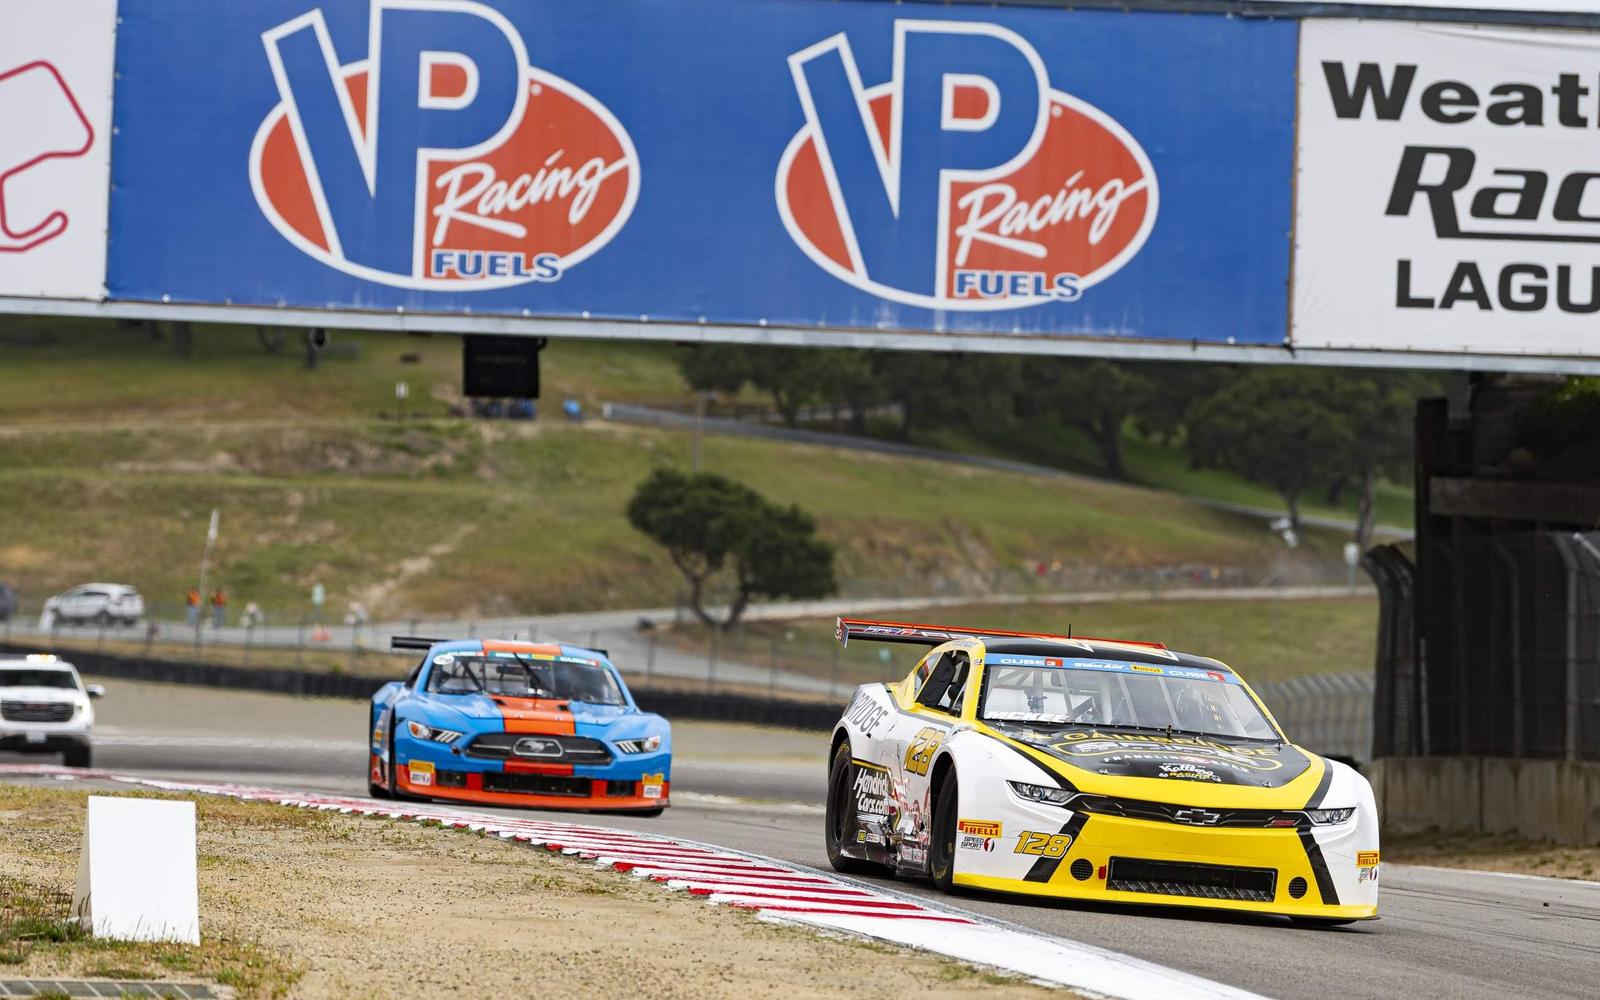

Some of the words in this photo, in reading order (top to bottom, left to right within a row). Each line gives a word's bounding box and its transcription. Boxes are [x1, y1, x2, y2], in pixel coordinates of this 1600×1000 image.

[1321, 61, 1600, 128] Weat
[261, 0, 530, 281] VP
[787, 18, 1051, 300] VP
[433, 149, 625, 246] Racing
[956, 170, 1144, 267] Racing
[432, 249, 562, 281] FUELS
[953, 268, 1084, 301] FUELS
[1396, 259, 1600, 314] LAGU
[903, 726, 947, 777] 128
[958, 820, 999, 836] PIRELLI
[1013, 830, 1072, 858] 128
